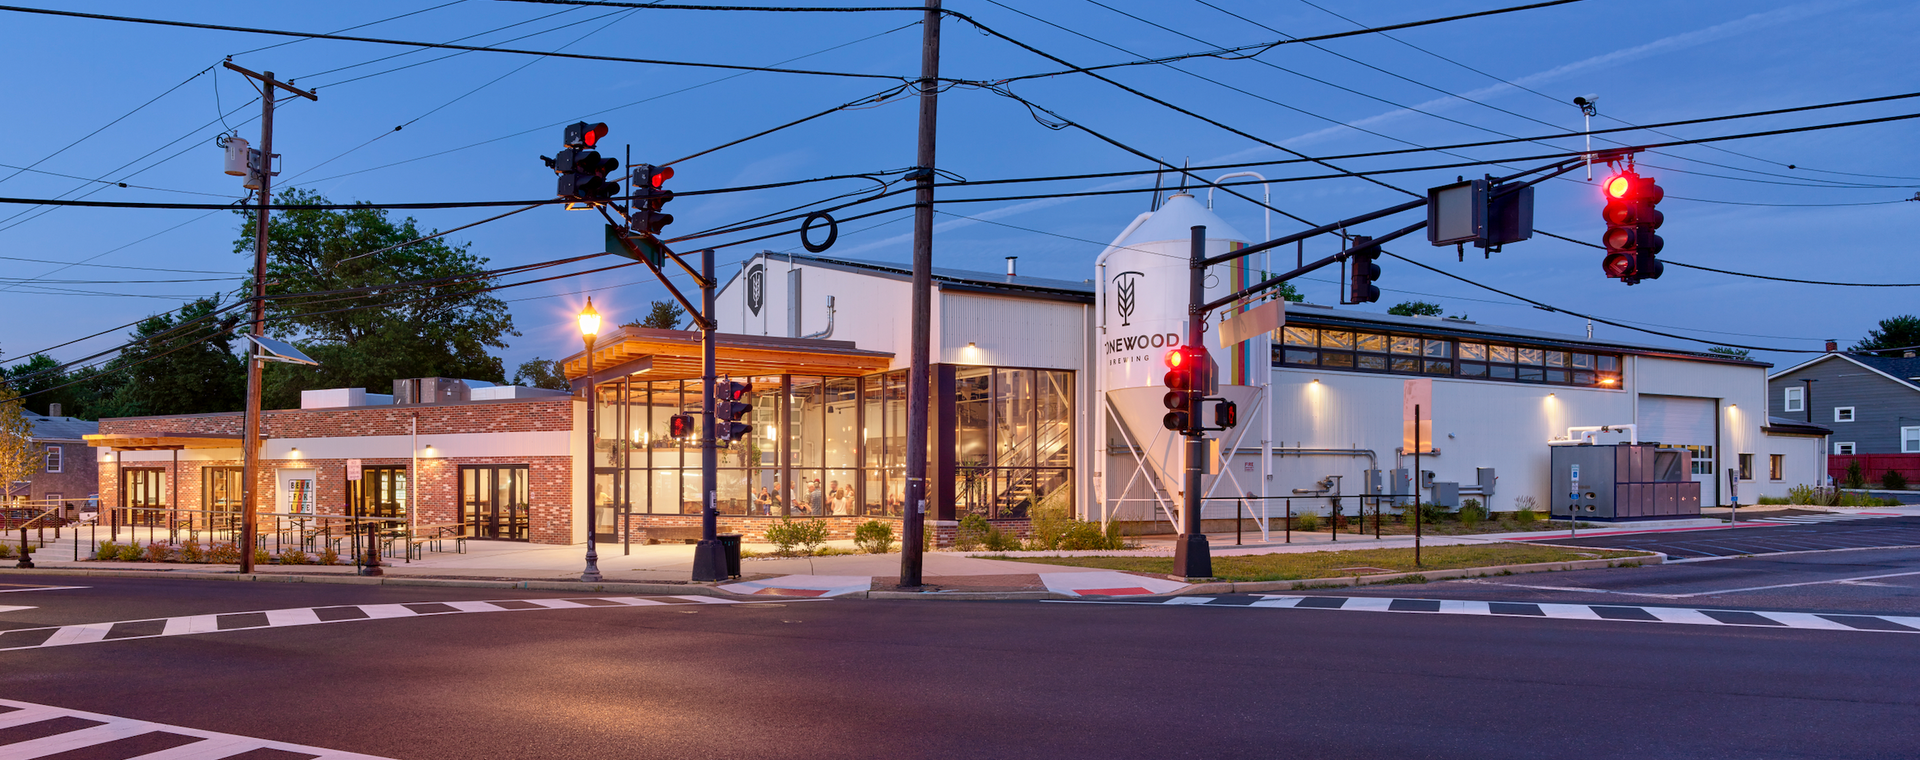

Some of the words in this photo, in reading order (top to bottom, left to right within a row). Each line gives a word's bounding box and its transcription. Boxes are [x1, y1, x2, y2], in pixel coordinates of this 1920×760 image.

[1109, 354, 1150, 366] BREWING
[290, 481, 311, 489] BEER
[290, 503, 310, 511] LIFE
